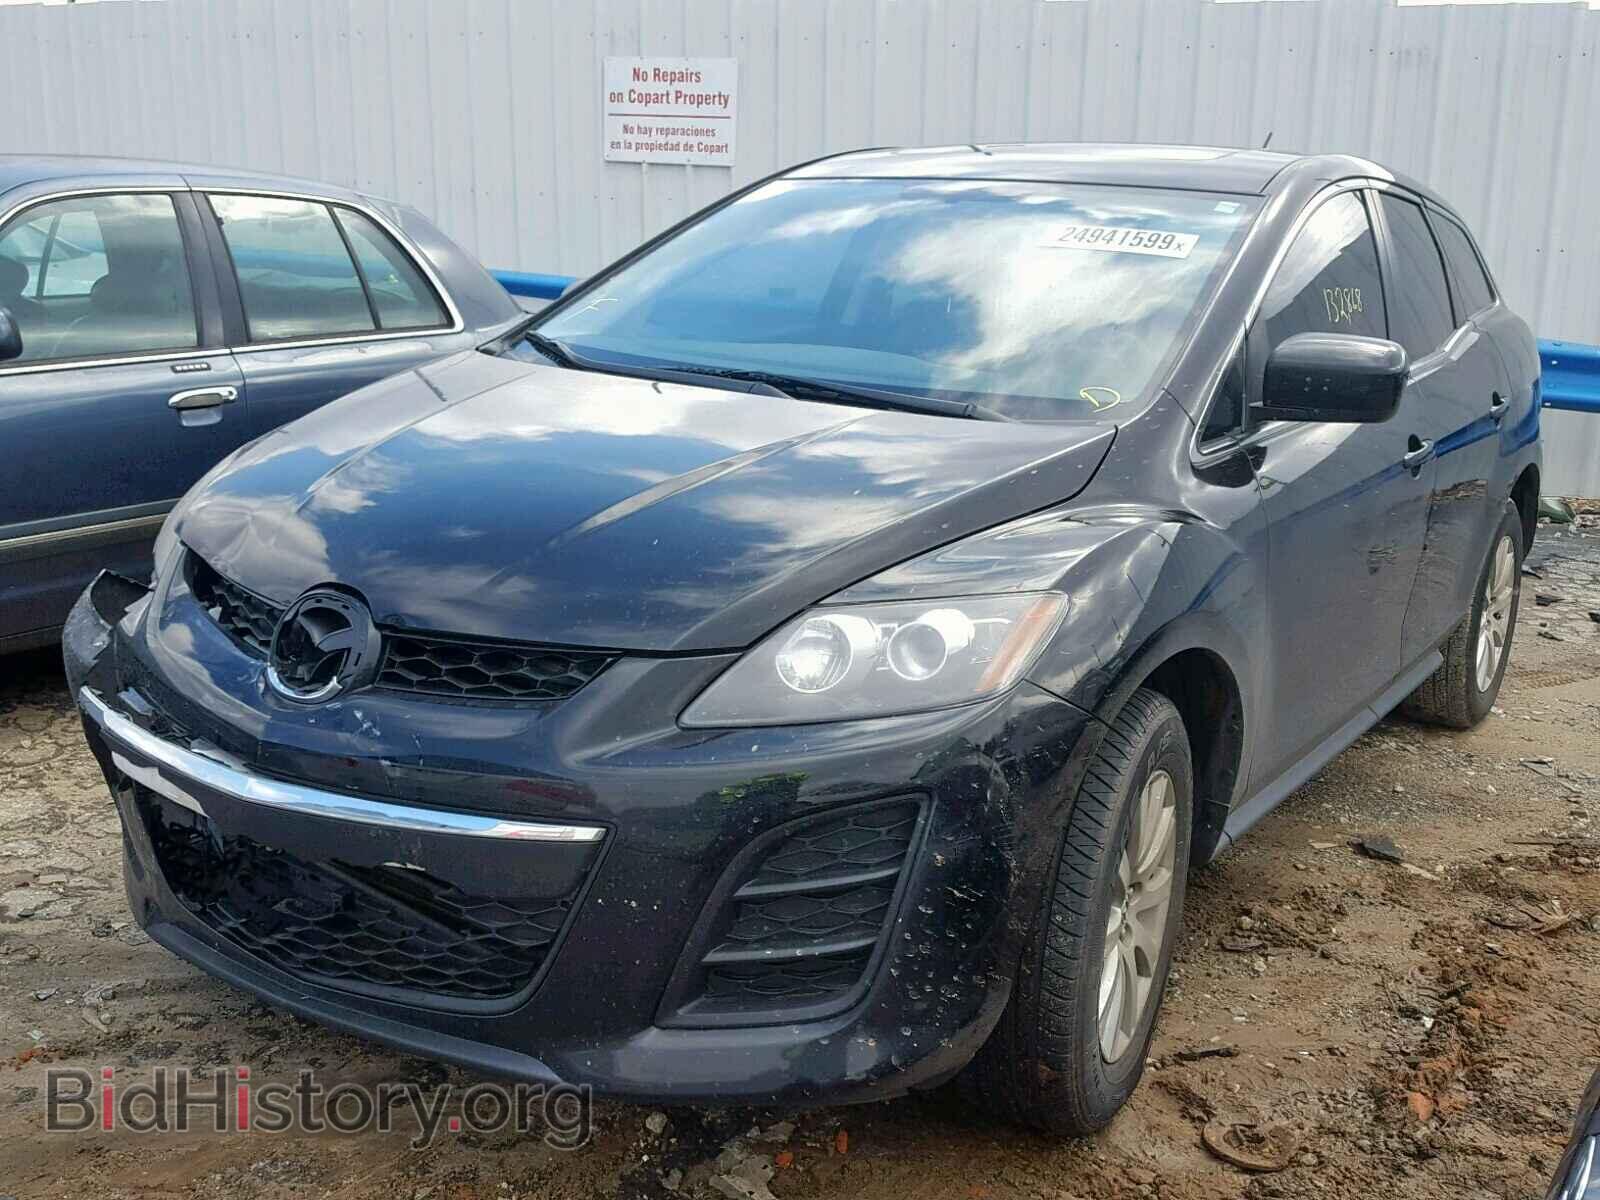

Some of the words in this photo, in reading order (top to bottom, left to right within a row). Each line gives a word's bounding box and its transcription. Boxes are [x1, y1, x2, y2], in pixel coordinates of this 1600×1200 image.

[632, 67, 648, 82] No
[653, 68, 701, 85] Repairs
[609, 91, 624, 103] on
[628, 89, 670, 106] Copart
[675, 91, 729, 108] Property
[623, 124, 634, 134] No
[637, 125, 652, 137] hay
[655, 126, 716, 137] reparaciones
[610, 141, 621, 149] en
[624, 140, 632, 149] la
[635, 140, 680, 153] propiedad
[683, 141, 694, 152] de
[697, 142, 728, 154] Copart
